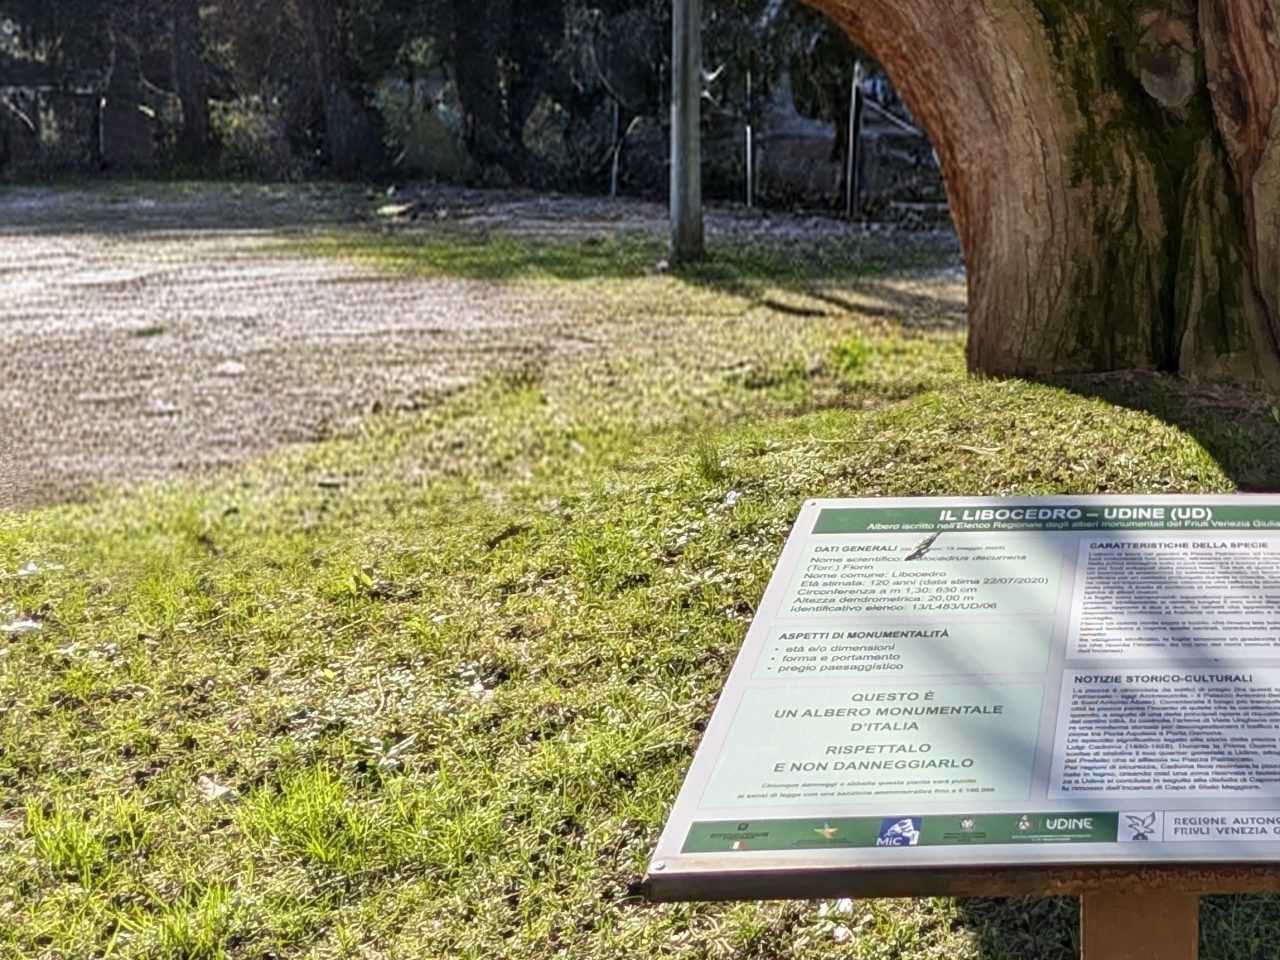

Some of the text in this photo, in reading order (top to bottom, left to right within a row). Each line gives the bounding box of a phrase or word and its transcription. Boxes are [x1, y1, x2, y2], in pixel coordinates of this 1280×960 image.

[939, 510, 956, 520] IL
[962, 509, 1080, 520] LIBOCEDRO
[1103, 507, 1164, 519] UDINE
[1170, 507, 1211, 520] (UD)
[847, 630, 948, 638] MONUMENTALITÀ
[1074, 675, 1122, 683] NOTIZIE
[852, 691, 934, 702] QUESTO È
[774, 705, 1002, 718] UN ALBERO MONUMENTALE
[850, 722, 918, 731] D'ITALIA
[826, 744, 931, 754] RISPETTALO
[774, 758, 974, 772] E NON DANNEGGIARLO
[1046, 818, 1094, 830] UDINE
[876, 838, 902, 846] MiC
